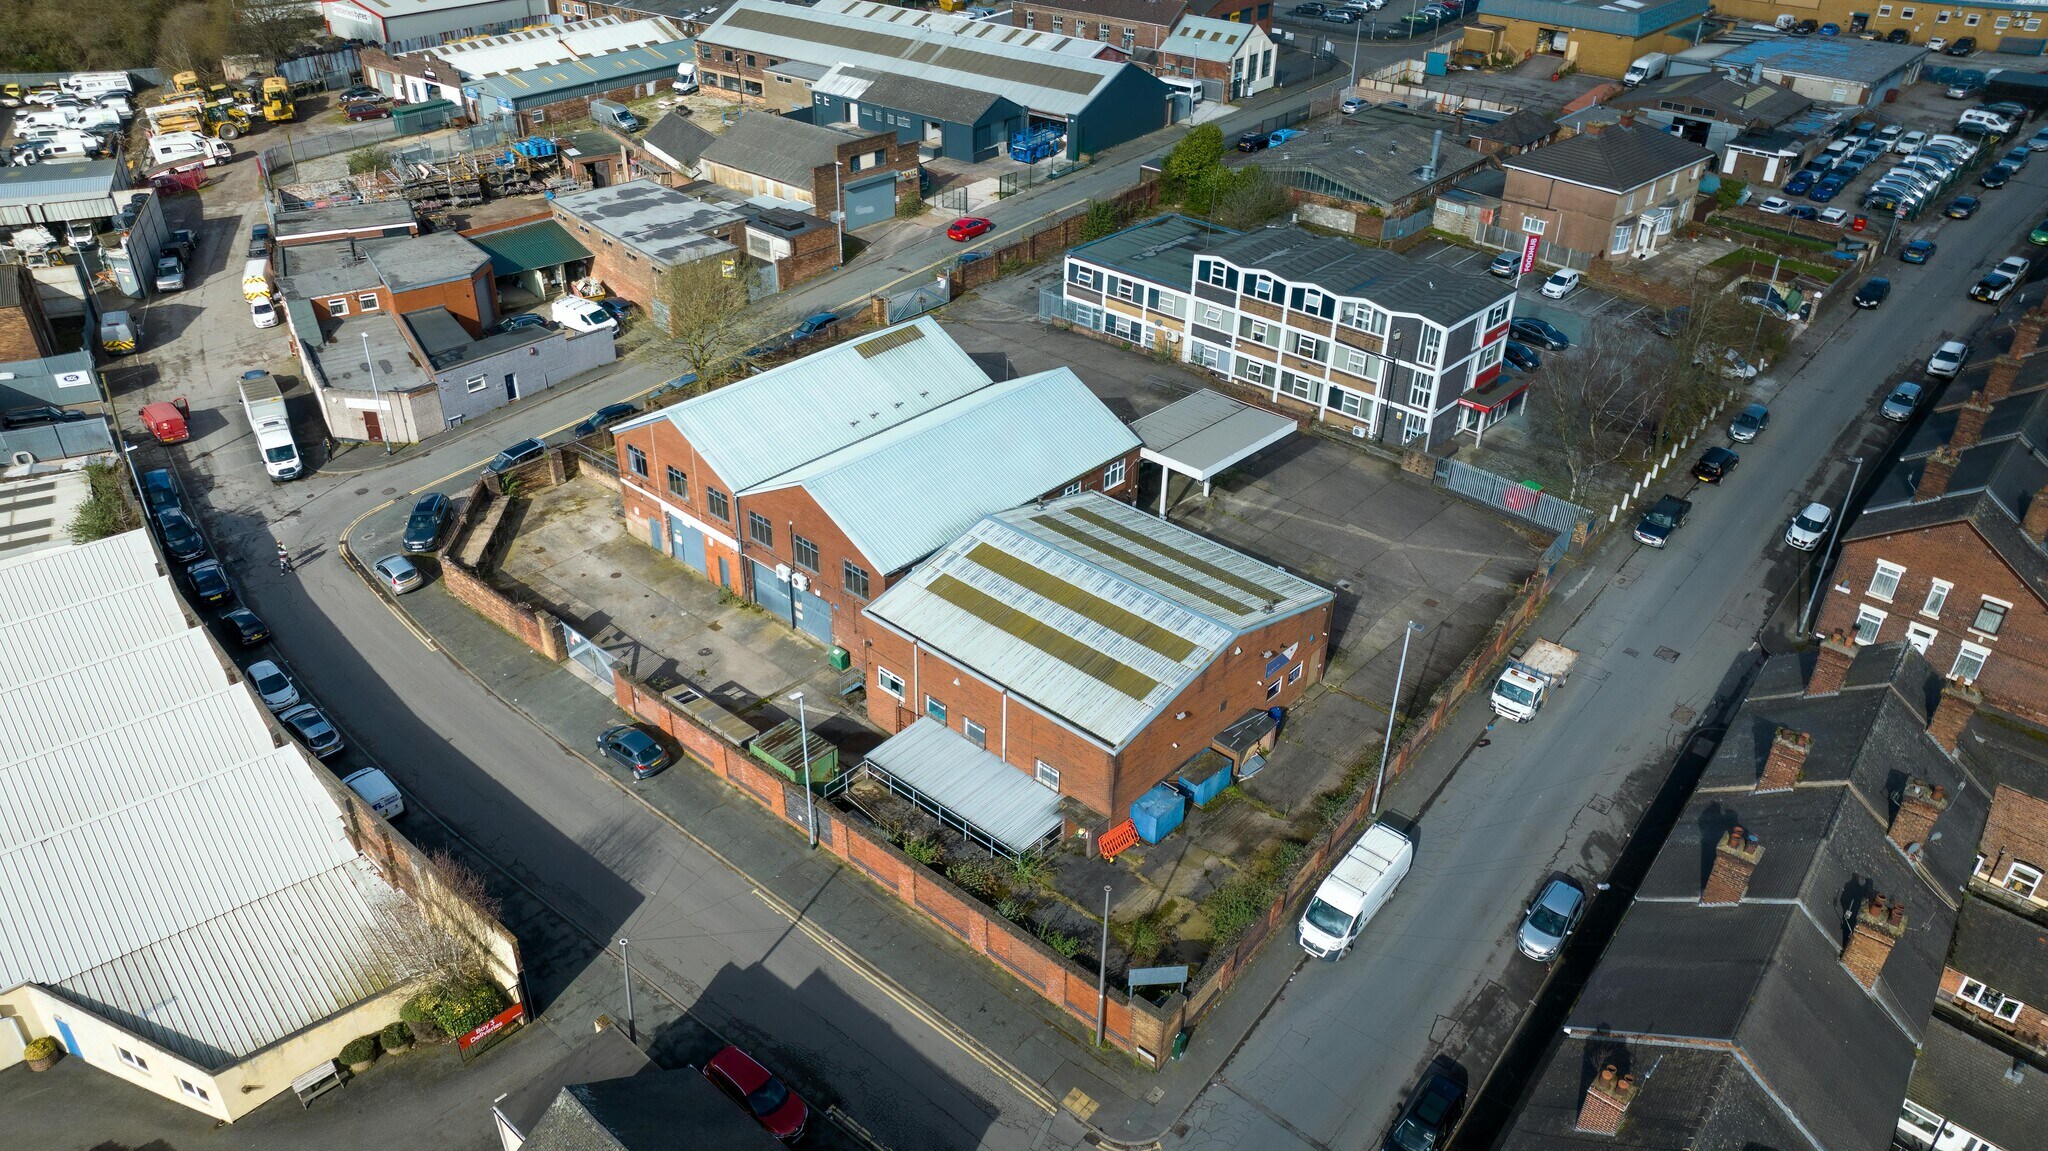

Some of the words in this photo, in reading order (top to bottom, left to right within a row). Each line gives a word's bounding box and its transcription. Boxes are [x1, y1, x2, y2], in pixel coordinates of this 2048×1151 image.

[1524, 238, 1537, 272] FOODHUB
[470, 1021, 503, 1043] Deliveries
[475, 1023, 489, 1035] Bay
